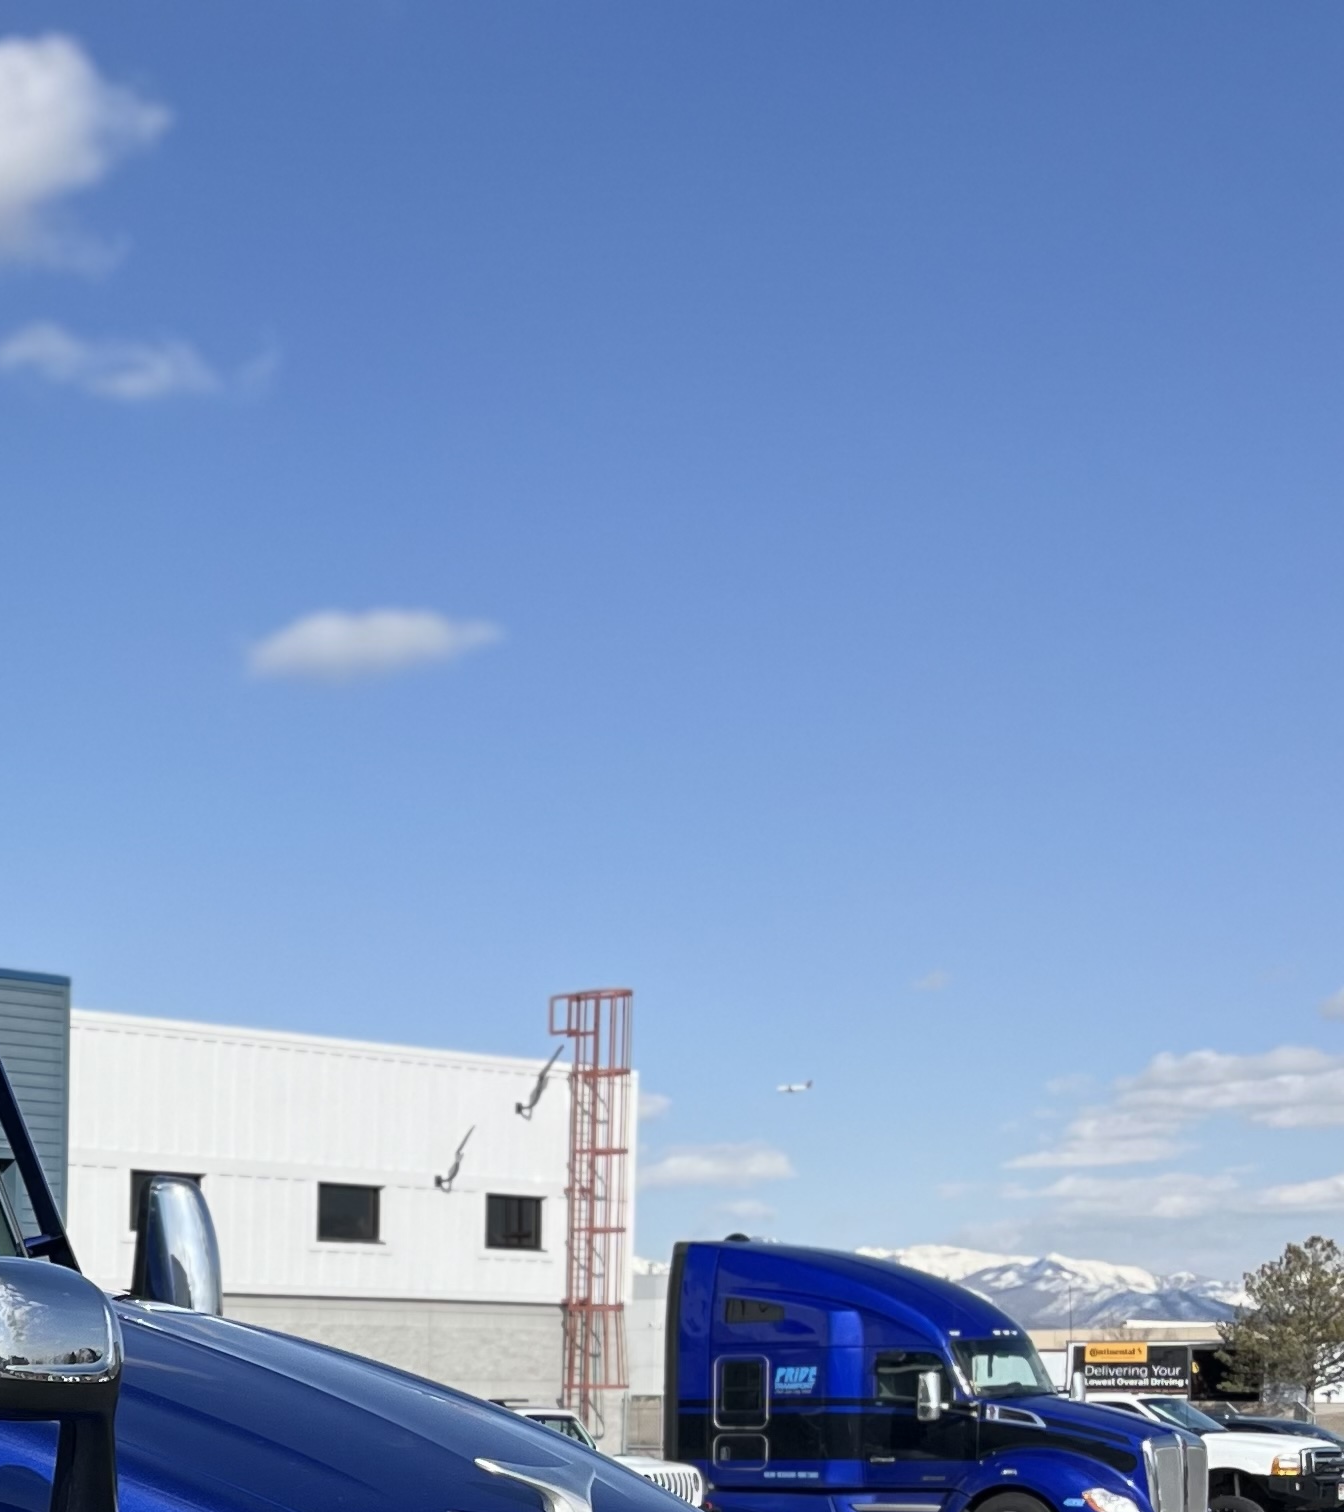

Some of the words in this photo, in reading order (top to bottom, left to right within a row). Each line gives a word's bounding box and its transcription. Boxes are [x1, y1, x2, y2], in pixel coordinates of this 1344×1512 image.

[1089, 1347, 1136, 1357] Continental
[775, 1366, 817, 1383] PRIDE
[1085, 1364, 1148, 1378] Delivering
[1151, 1364, 1182, 1377] Your
[1084, 1378, 1115, 1387] Lowest
[1117, 1377, 1149, 1386] Overall
[1150, 1377, 1185, 1388] Driving
